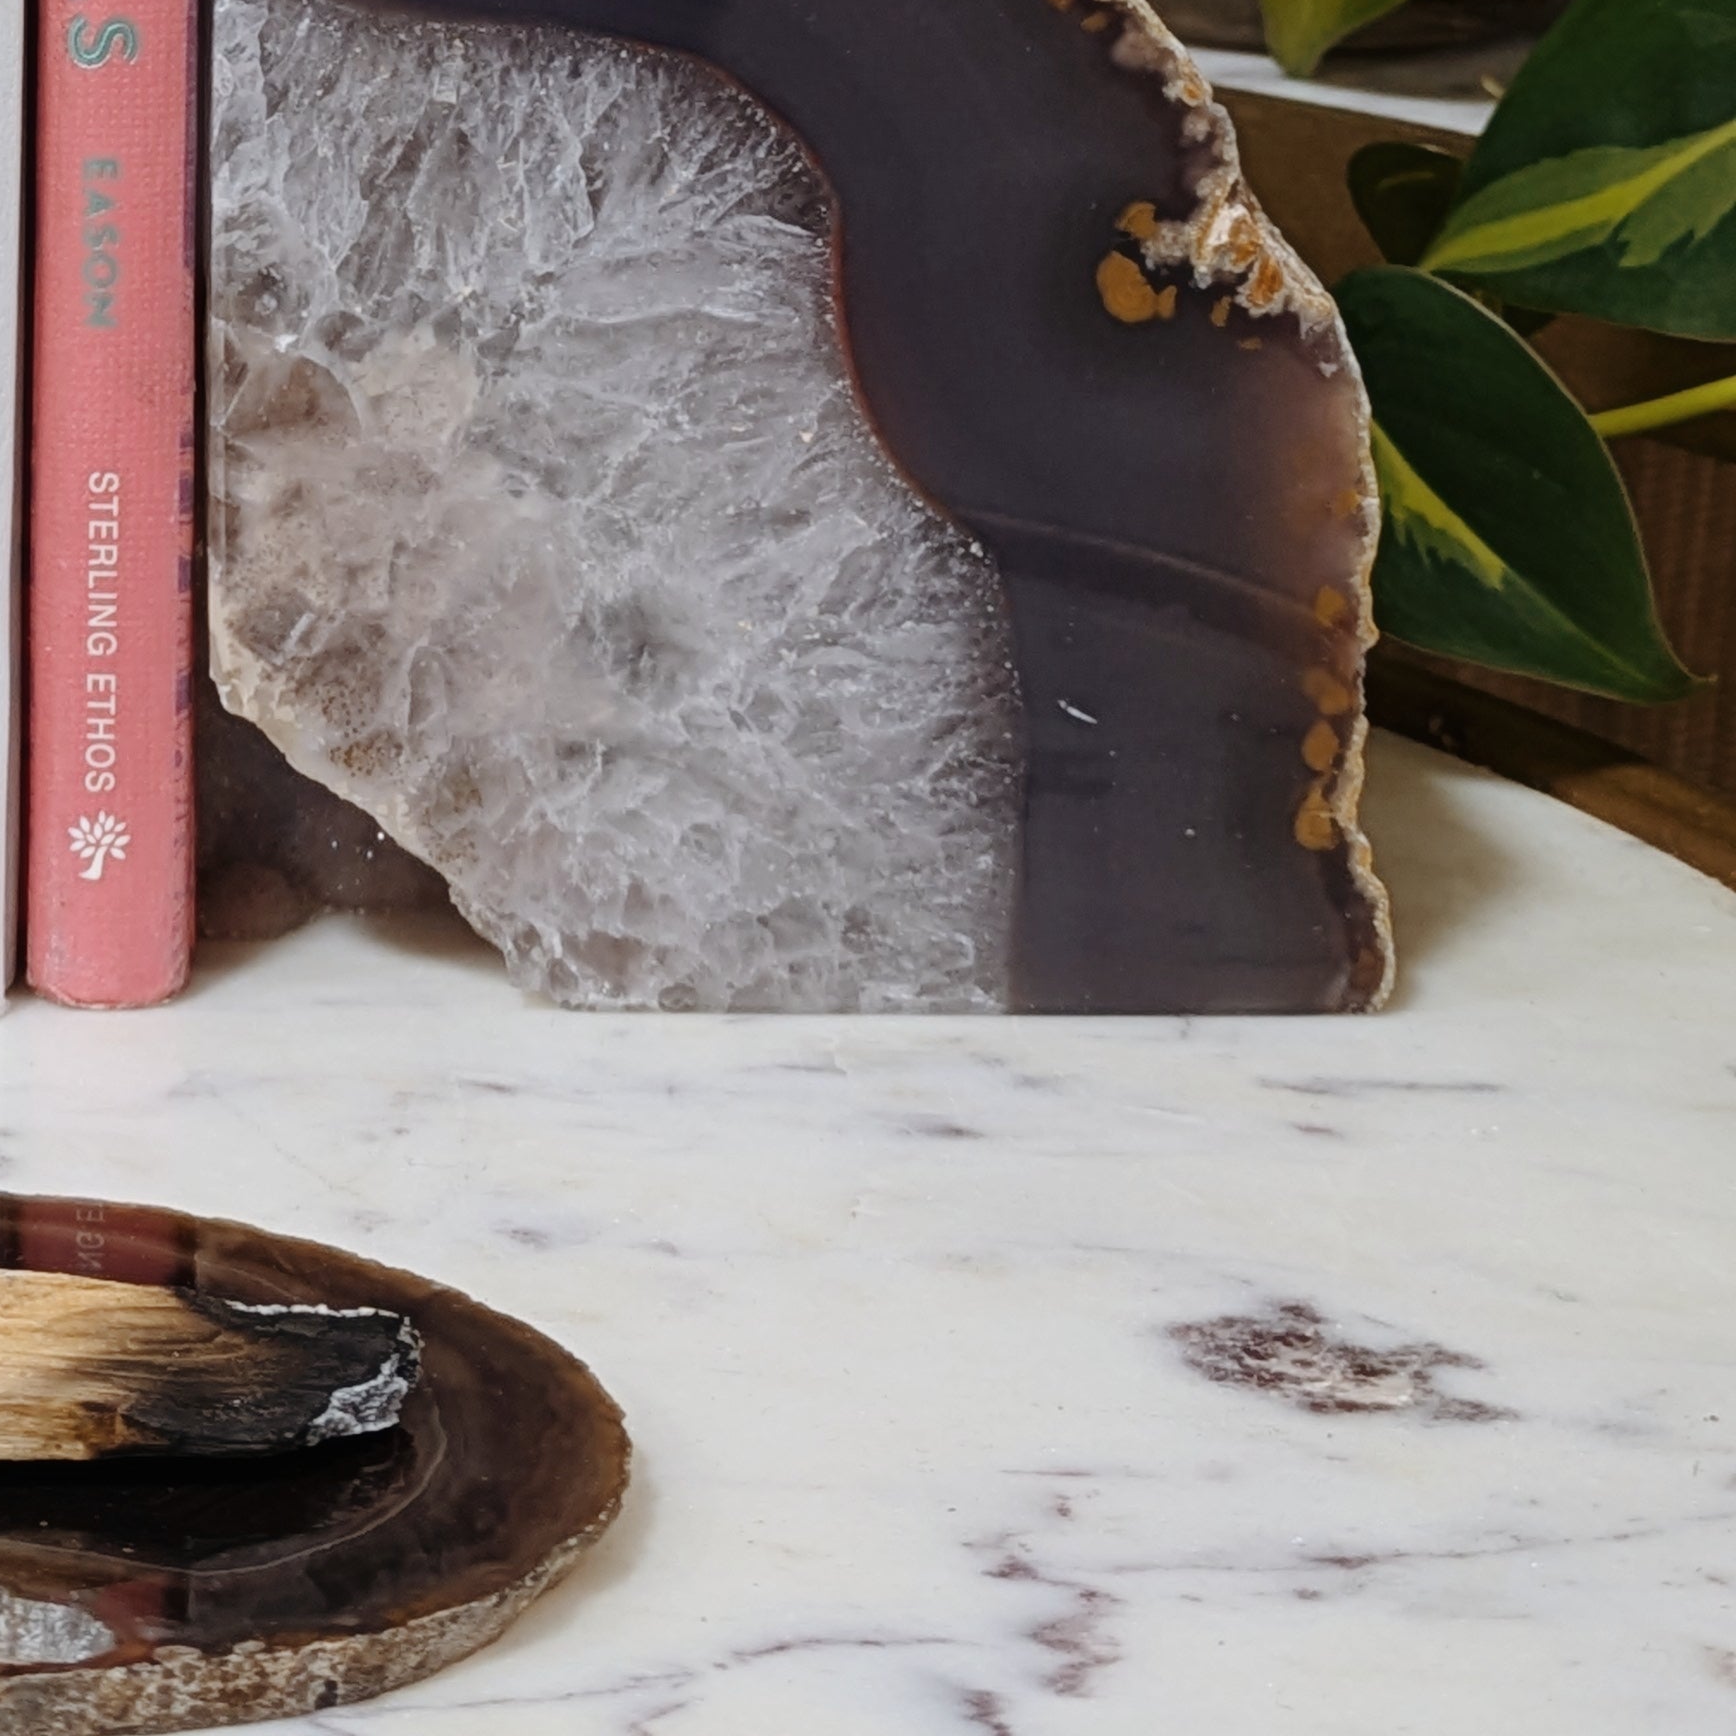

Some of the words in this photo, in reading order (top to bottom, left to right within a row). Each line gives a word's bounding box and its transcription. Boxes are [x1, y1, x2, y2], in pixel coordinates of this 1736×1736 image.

[82, 156, 119, 331] EASON
[86, 470, 120, 658] STERLING
[84, 672, 118, 794] ETHOS
